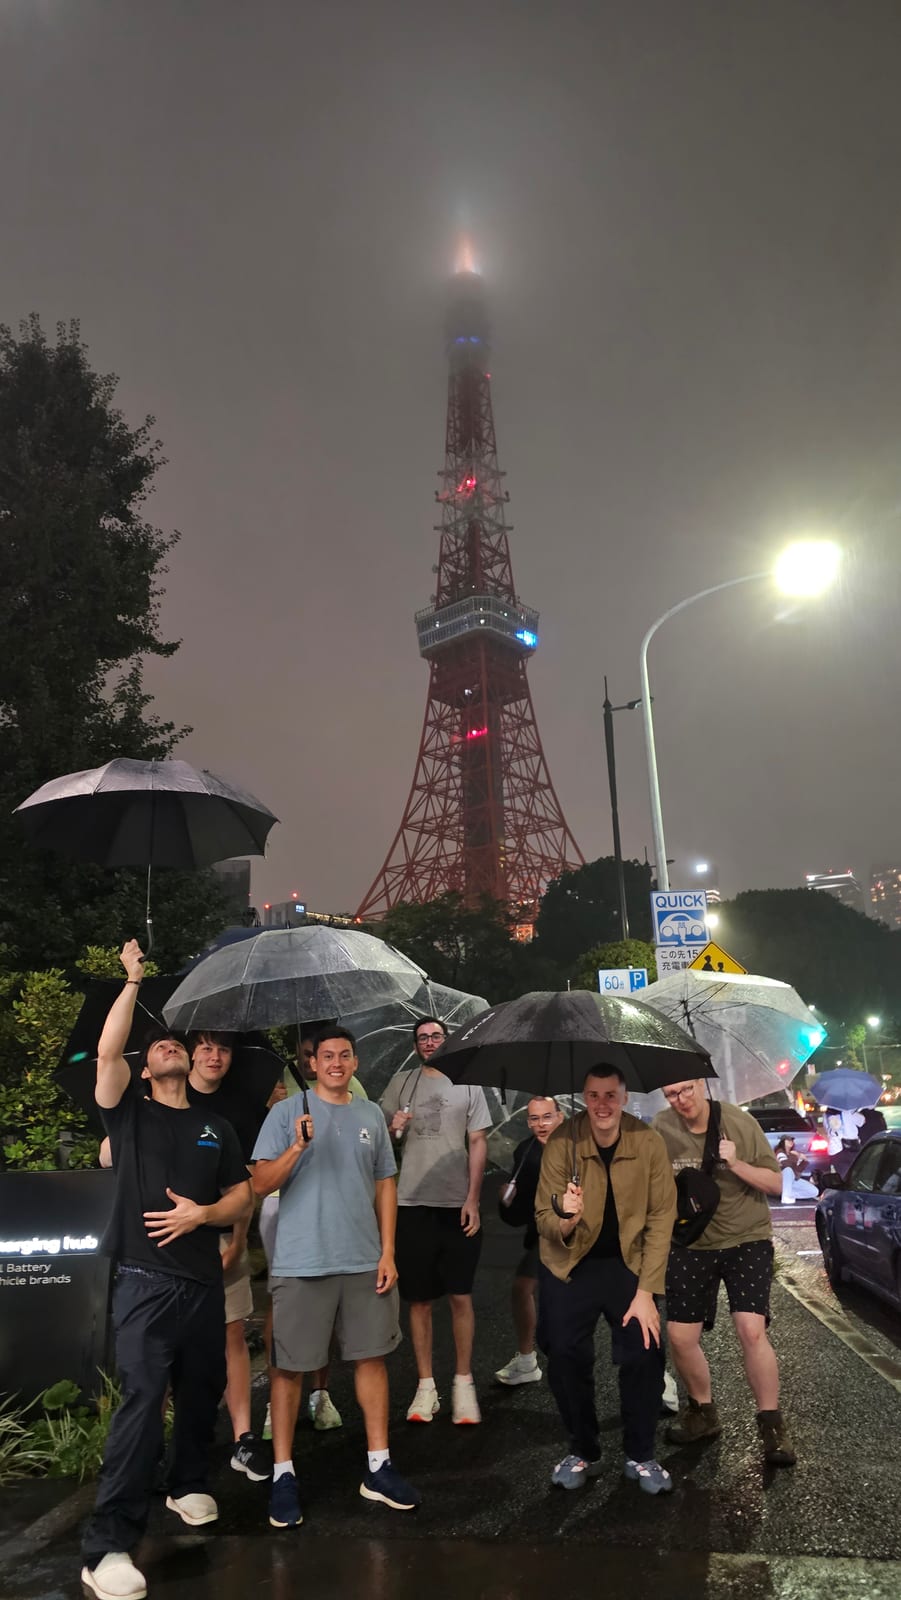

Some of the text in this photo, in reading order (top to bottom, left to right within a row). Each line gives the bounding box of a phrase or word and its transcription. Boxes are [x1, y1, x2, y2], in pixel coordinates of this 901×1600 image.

[655, 895, 704, 908] QUICK
[633, 972, 643, 986] P
[63, 1235, 98, 1250] hub
[6, 1263, 52, 1274] Battery
[29, 1274, 72, 1285] brands
